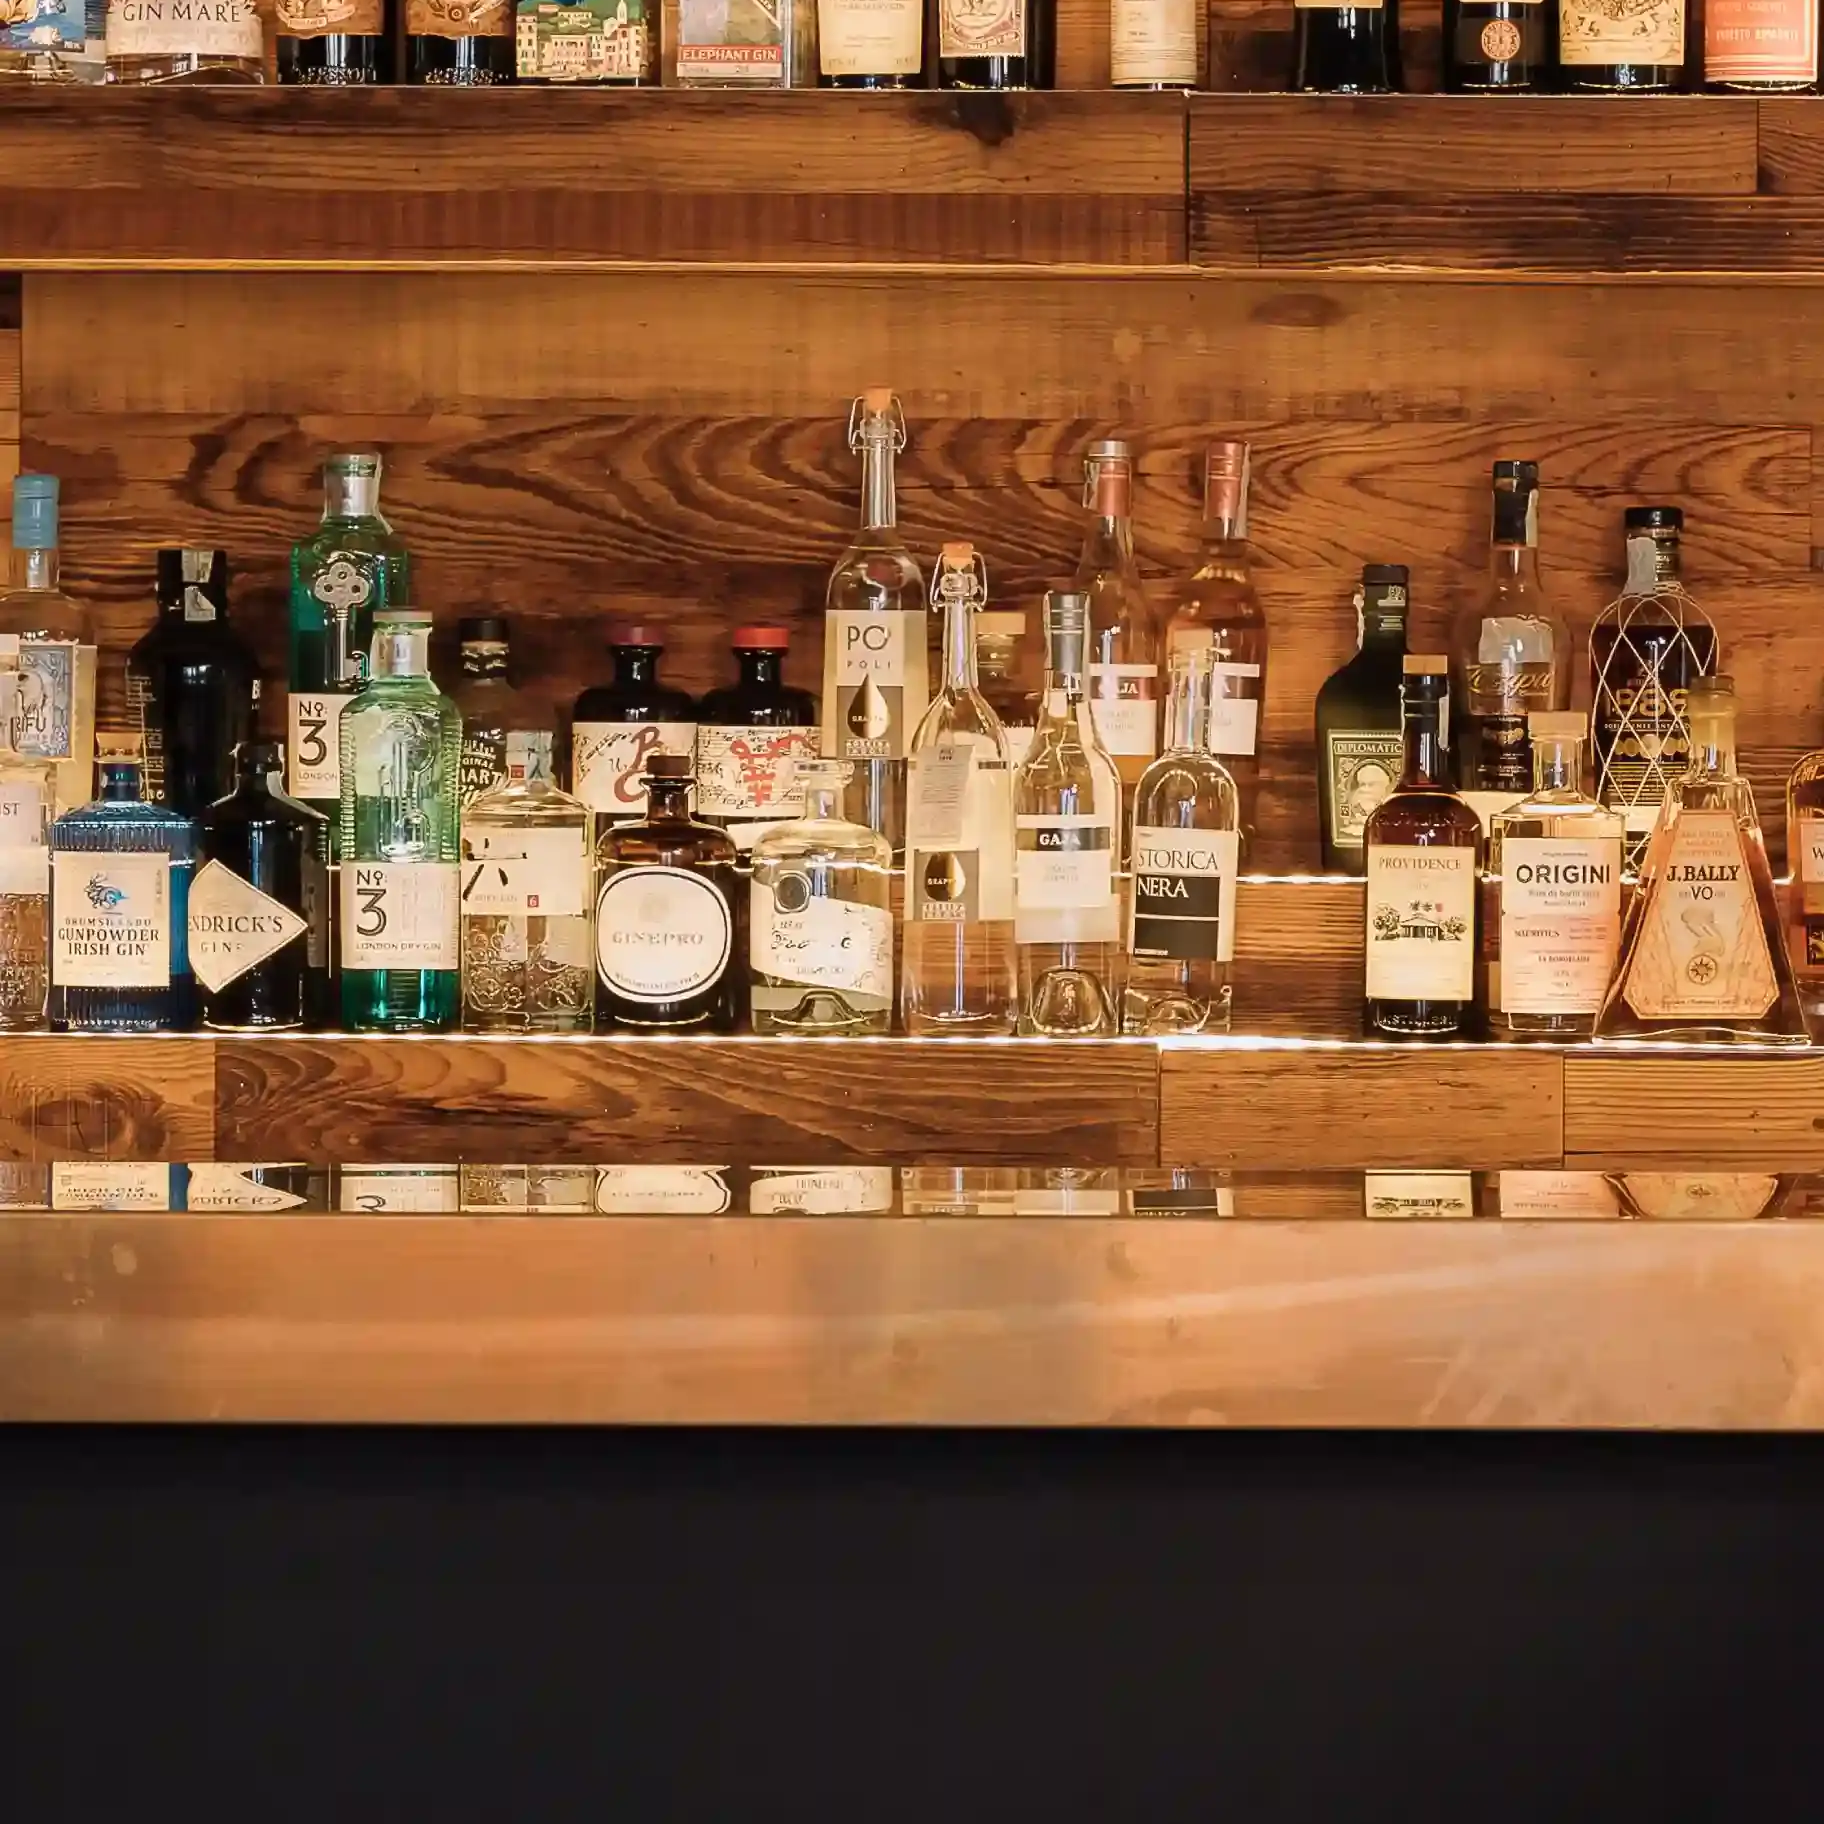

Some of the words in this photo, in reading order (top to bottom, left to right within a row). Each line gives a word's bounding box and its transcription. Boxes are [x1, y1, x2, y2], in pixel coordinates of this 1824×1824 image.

[123, 3, 162, 22] GIN
[172, 3, 243, 23] MARE
[681, 48, 749, 62] ELEPHANT
[752, 47, 778, 61] GIN
[847, 659, 892, 669] POLI
[298, 718, 327, 767] 3
[298, 771, 338, 781] LONDON
[1137, 847, 1219, 871] STORICA
[1378, 855, 1462, 871] PROVIDENCE
[1666, 863, 1741, 883] J.BALLY
[1137, 876, 1189, 899] NERA
[1690, 885, 1714, 900] VO
[355, 888, 387, 937] 3
[57, 928, 160, 943] GUNPOWDER
[611, 931, 706, 946] GINEPRO
[67, 943, 111, 957] IRISH
[115, 943, 148, 957] GIN
[355, 941, 399, 951] LONDON
[400, 941, 422, 951] DRY
[423, 941, 442, 951] GIN
